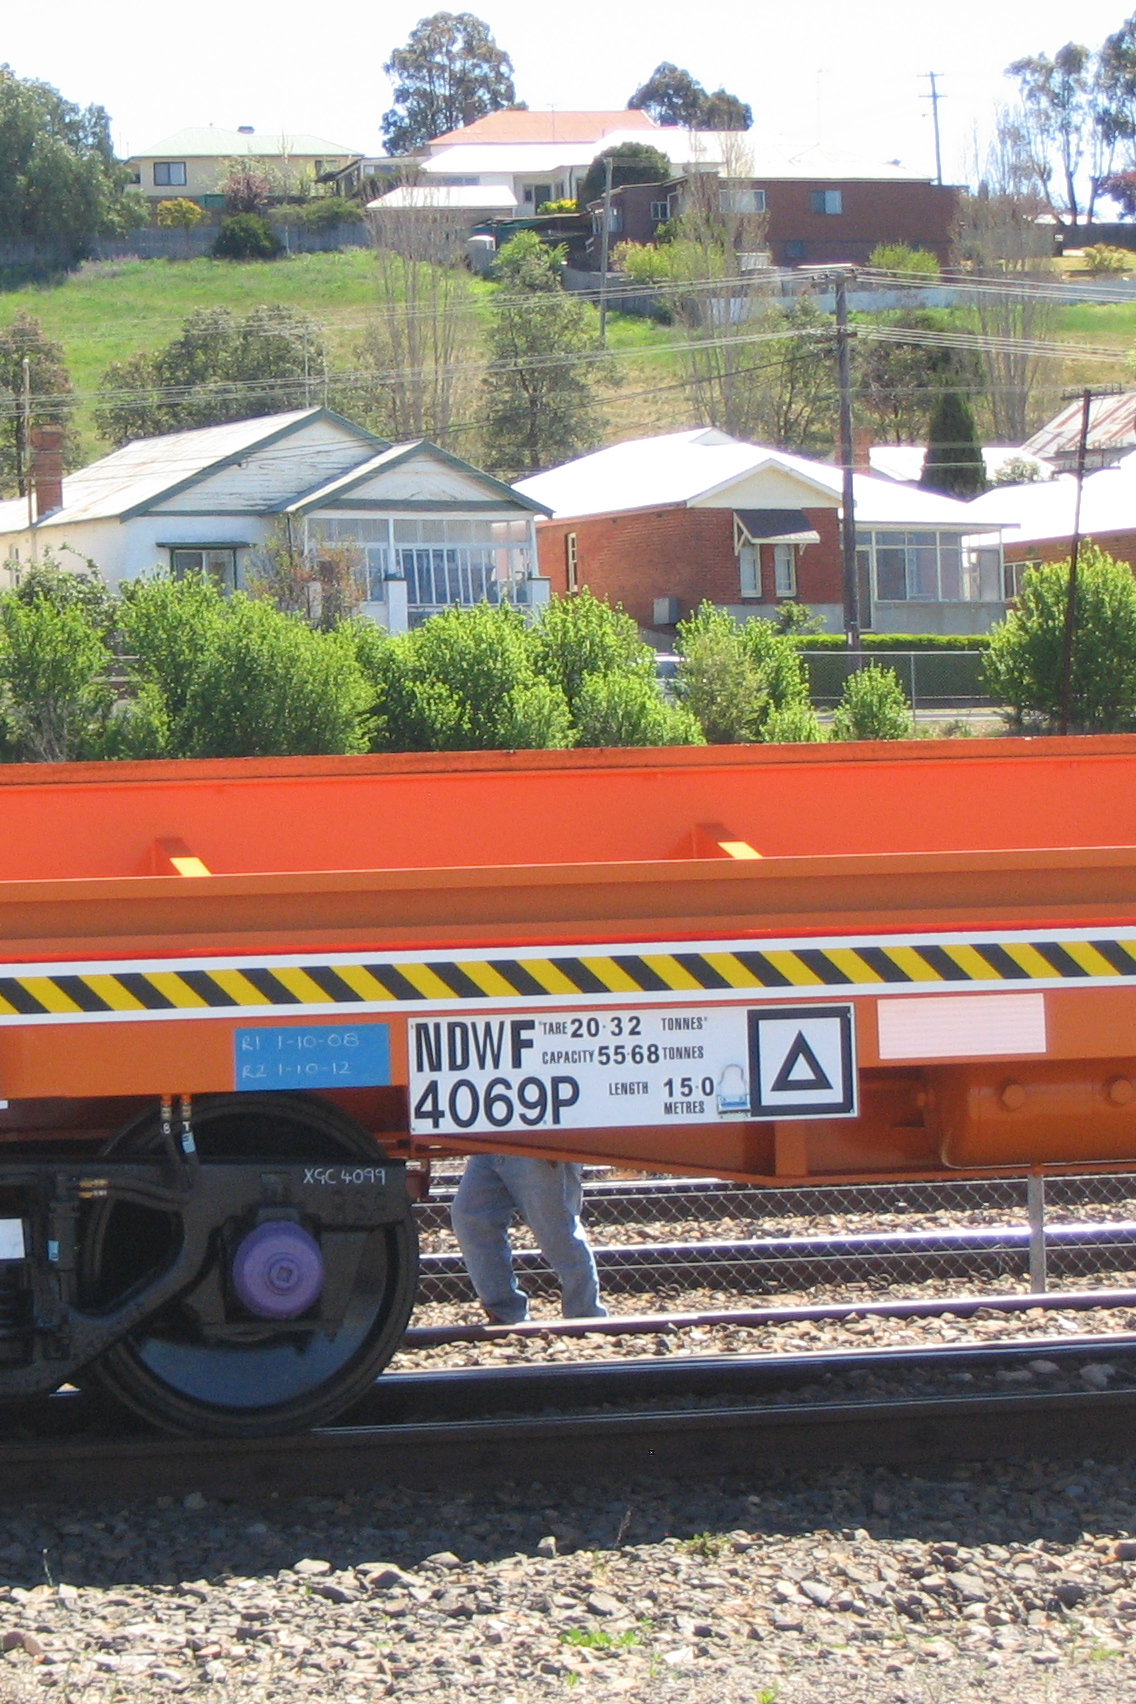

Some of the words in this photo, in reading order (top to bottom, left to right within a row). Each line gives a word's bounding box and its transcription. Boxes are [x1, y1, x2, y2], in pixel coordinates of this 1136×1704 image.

[542, 1021, 568, 1035] TARE
[661, 1017, 703, 1031] TONNES
[241, 1035, 260, 1051] R1
[277, 1033, 360, 1050] 1-10-08
[415, 1019, 536, 1073] NDWF
[542, 1049, 595, 1065] CAPACITY
[662, 1045, 704, 1060] TONNES
[242, 1064, 267, 1079] R2
[278, 1061, 351, 1076] 1-10-12
[608, 1081, 649, 1096] LENGTH
[414, 1075, 580, 1129] 4069P
[664, 1101, 705, 1115] METRES
[340, 1168, 386, 1186] 4099
